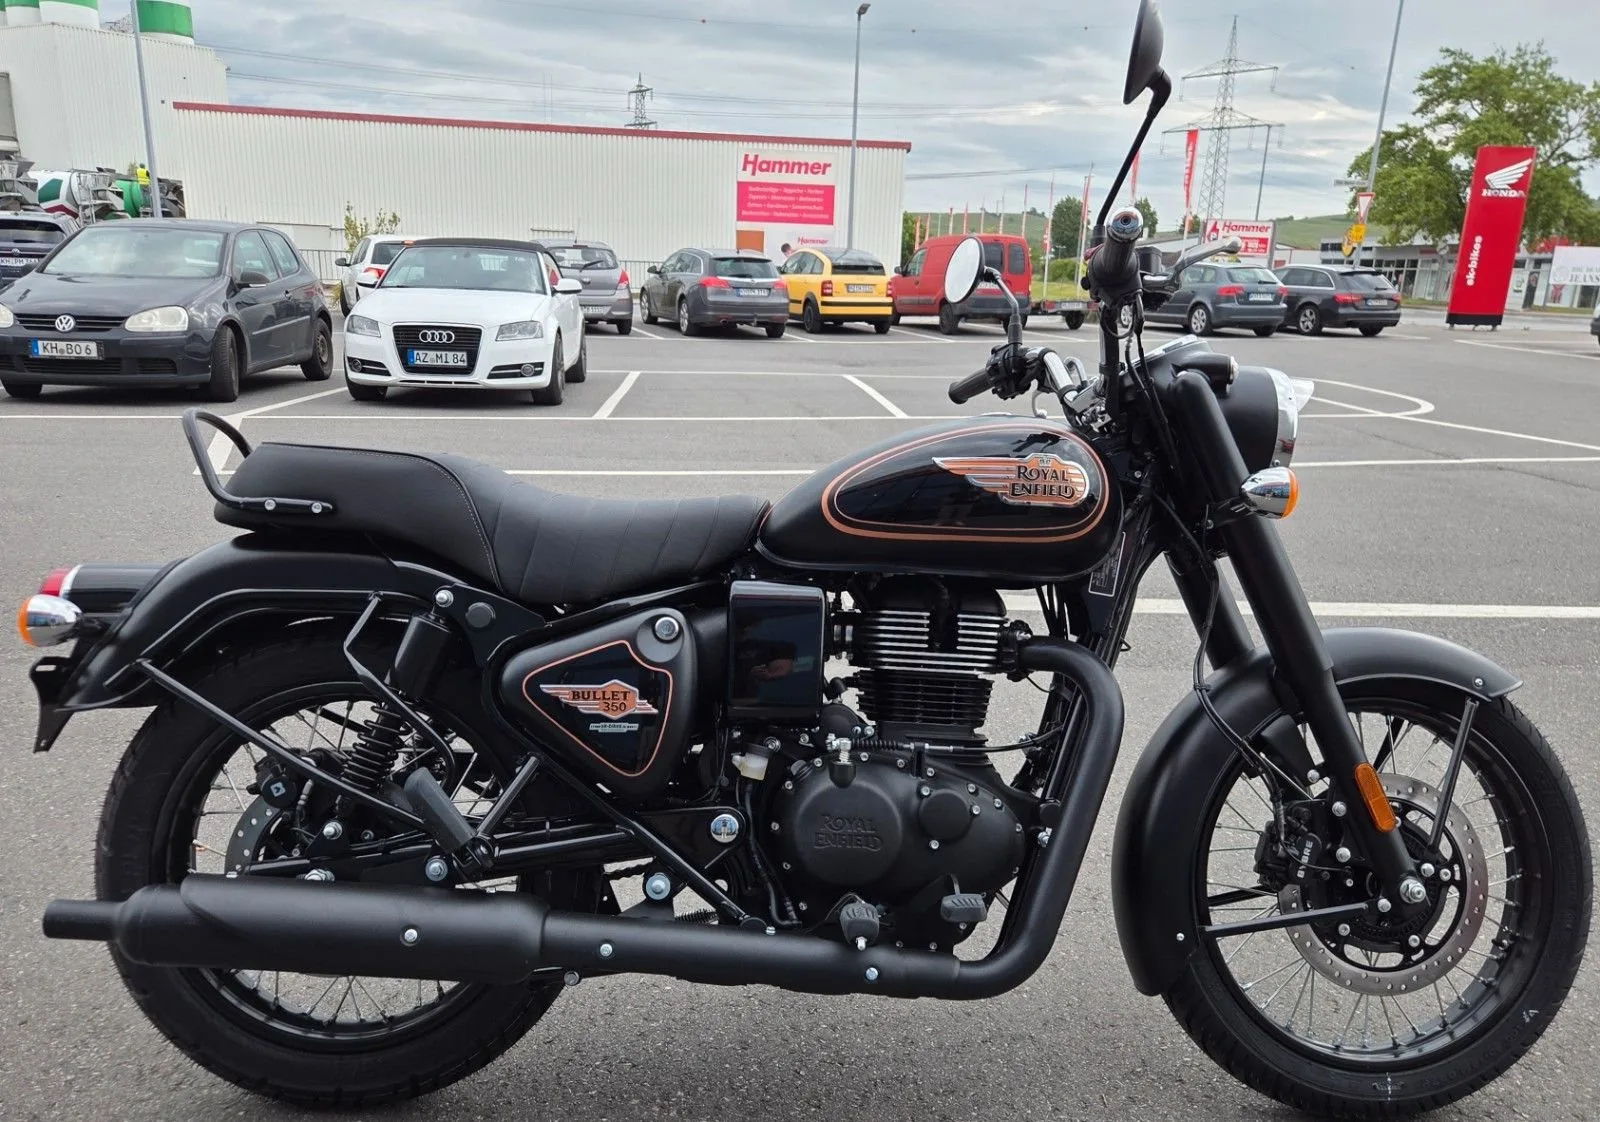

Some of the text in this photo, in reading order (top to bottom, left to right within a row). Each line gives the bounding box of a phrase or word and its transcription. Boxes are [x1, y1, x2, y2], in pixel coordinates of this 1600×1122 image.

[742, 153, 832, 176] Hammer
[1481, 189, 1527, 198] HONDA
[1222, 220, 1271, 233] Hammer
[42, 341, 59, 354] KH
[84, 344, 92, 355] 6
[415, 351, 466, 365] AZ MI 84
[1016, 465, 1069, 482] ROYAL
[1010, 482, 1075, 499] ENFIELD
[571, 690, 630, 701] BULLET
[603, 701, 627, 712] 350
[820, 813, 876, 833] ROYAL
[814, 831, 883, 852] ENFIELD
